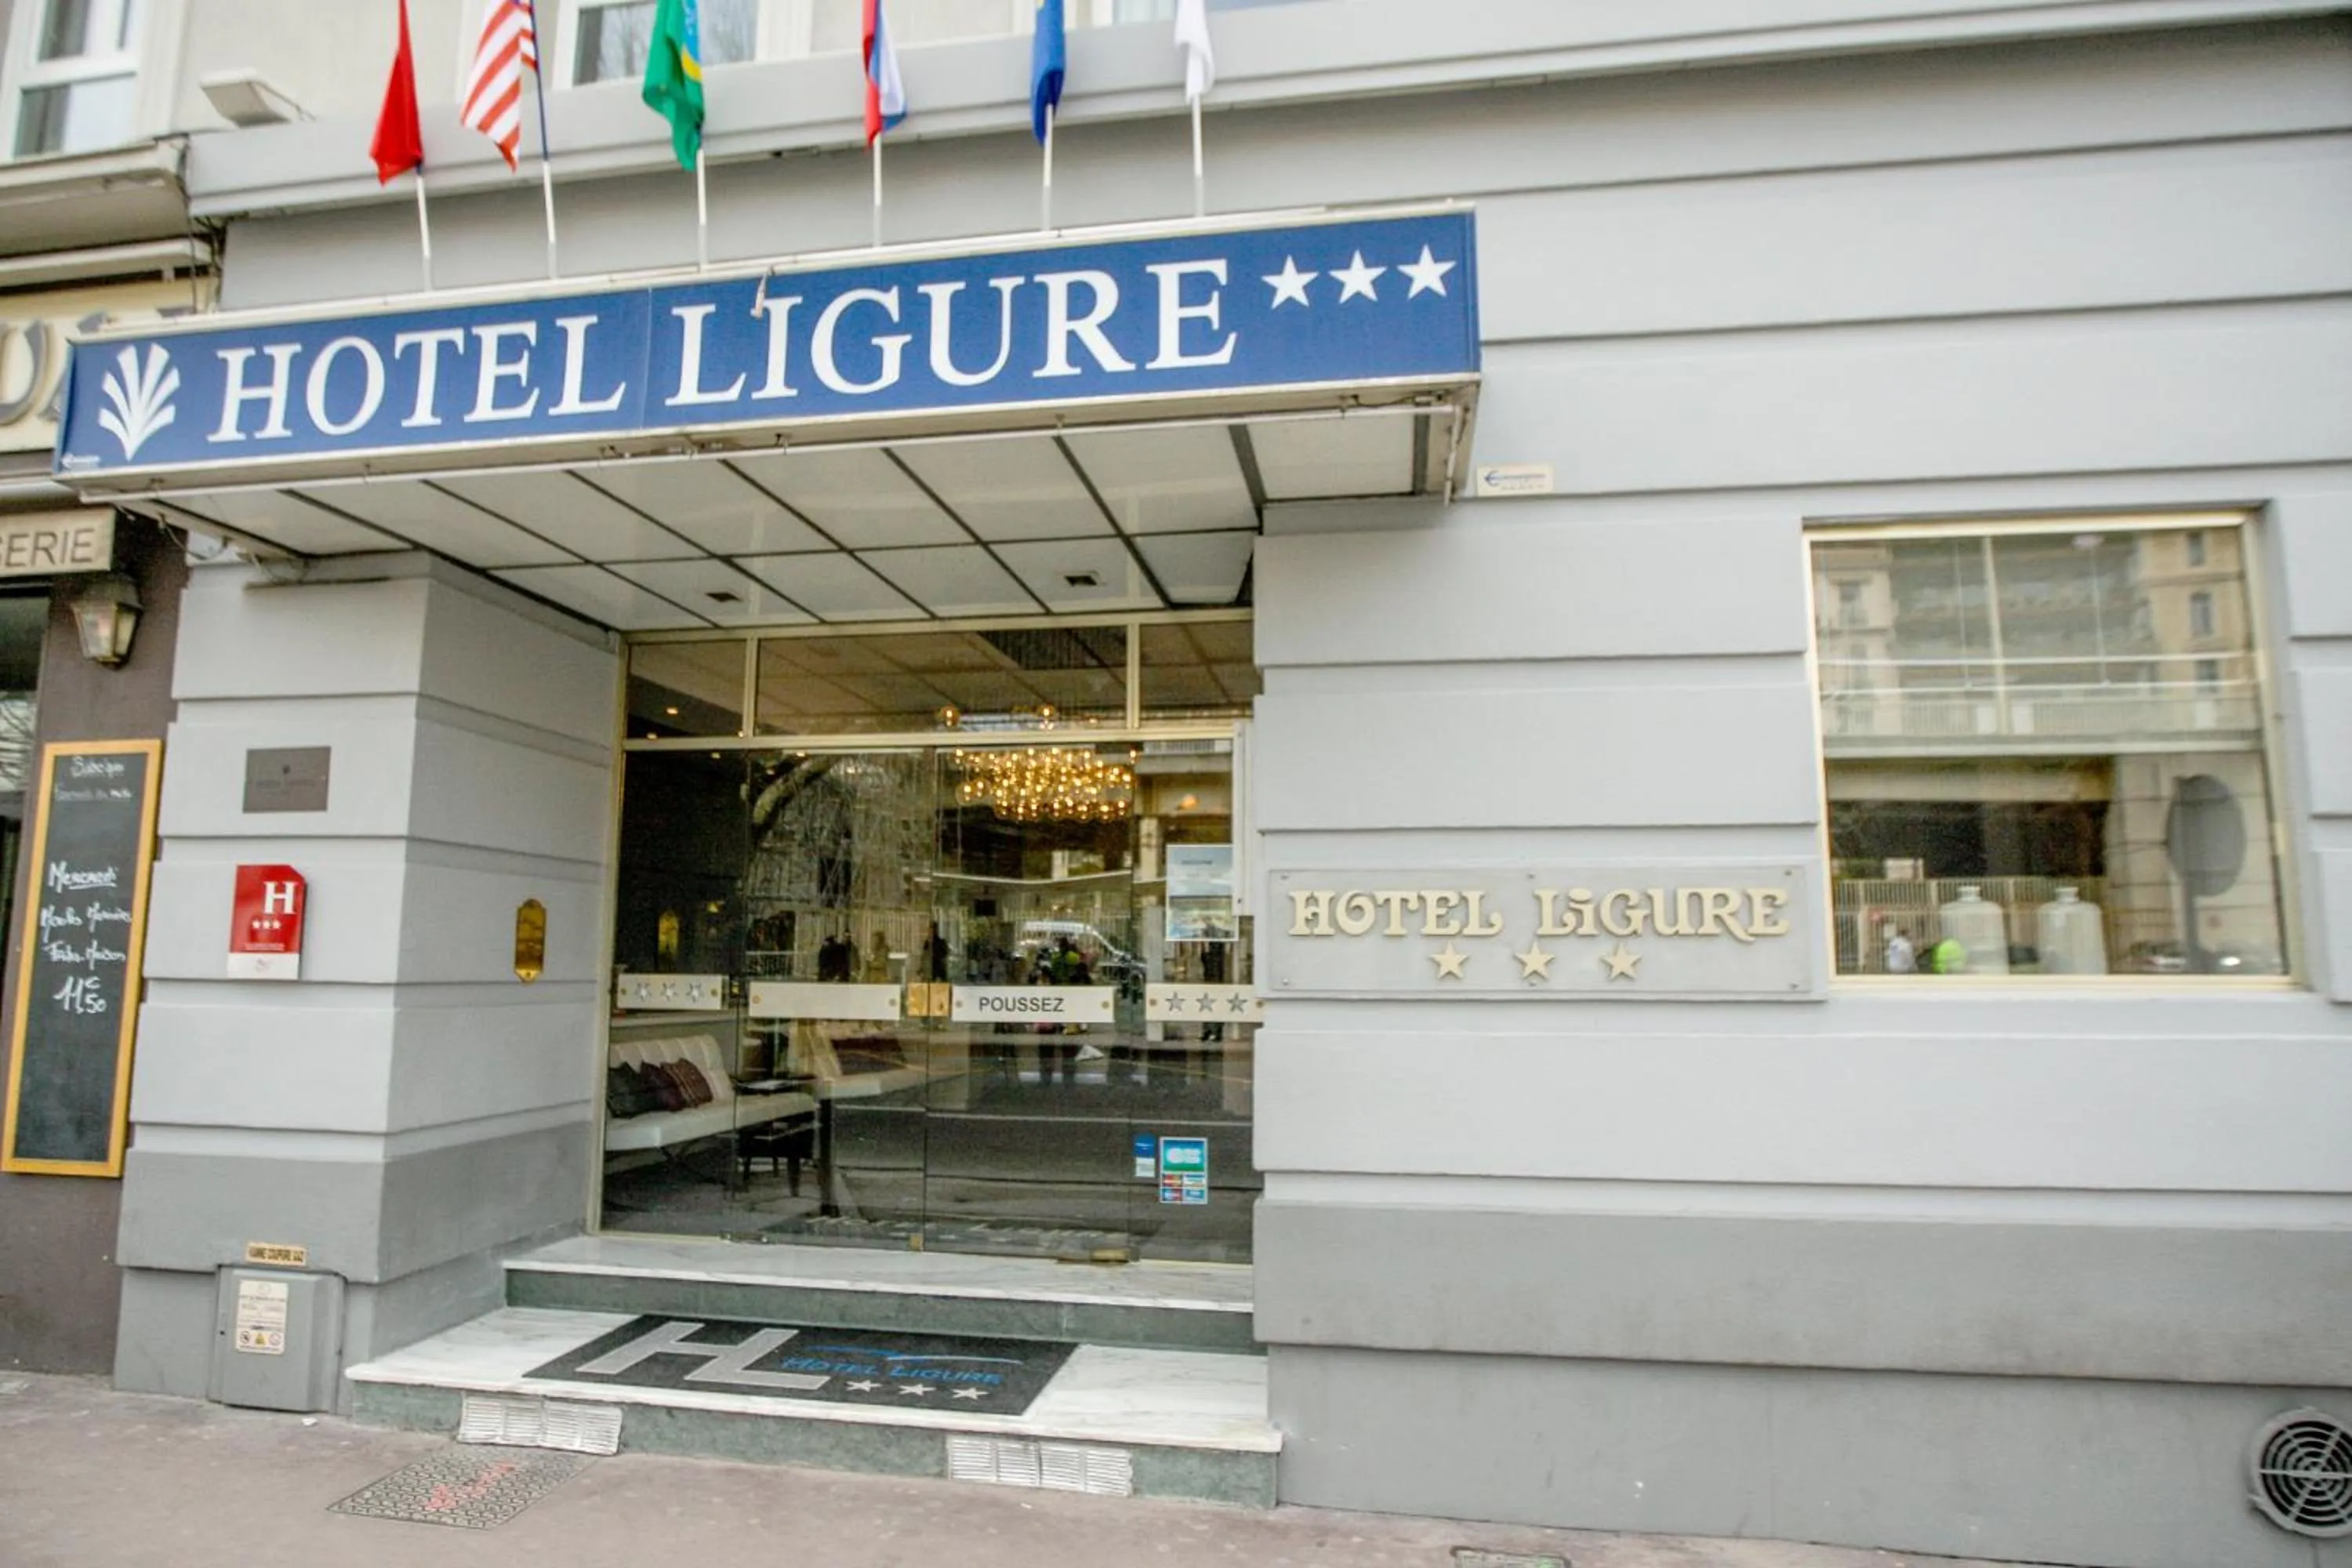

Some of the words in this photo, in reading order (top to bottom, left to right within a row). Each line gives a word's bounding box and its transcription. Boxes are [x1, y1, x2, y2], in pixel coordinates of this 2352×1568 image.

[207, 314, 627, 442] HOTEL
[664, 258, 1238, 407] LIGURE
[0, 528, 95, 568] ERIE
[263, 881, 298, 914] H
[1289, 889, 1503, 936] HOTEL
[978, 996, 1065, 1013] POUSSEZ
